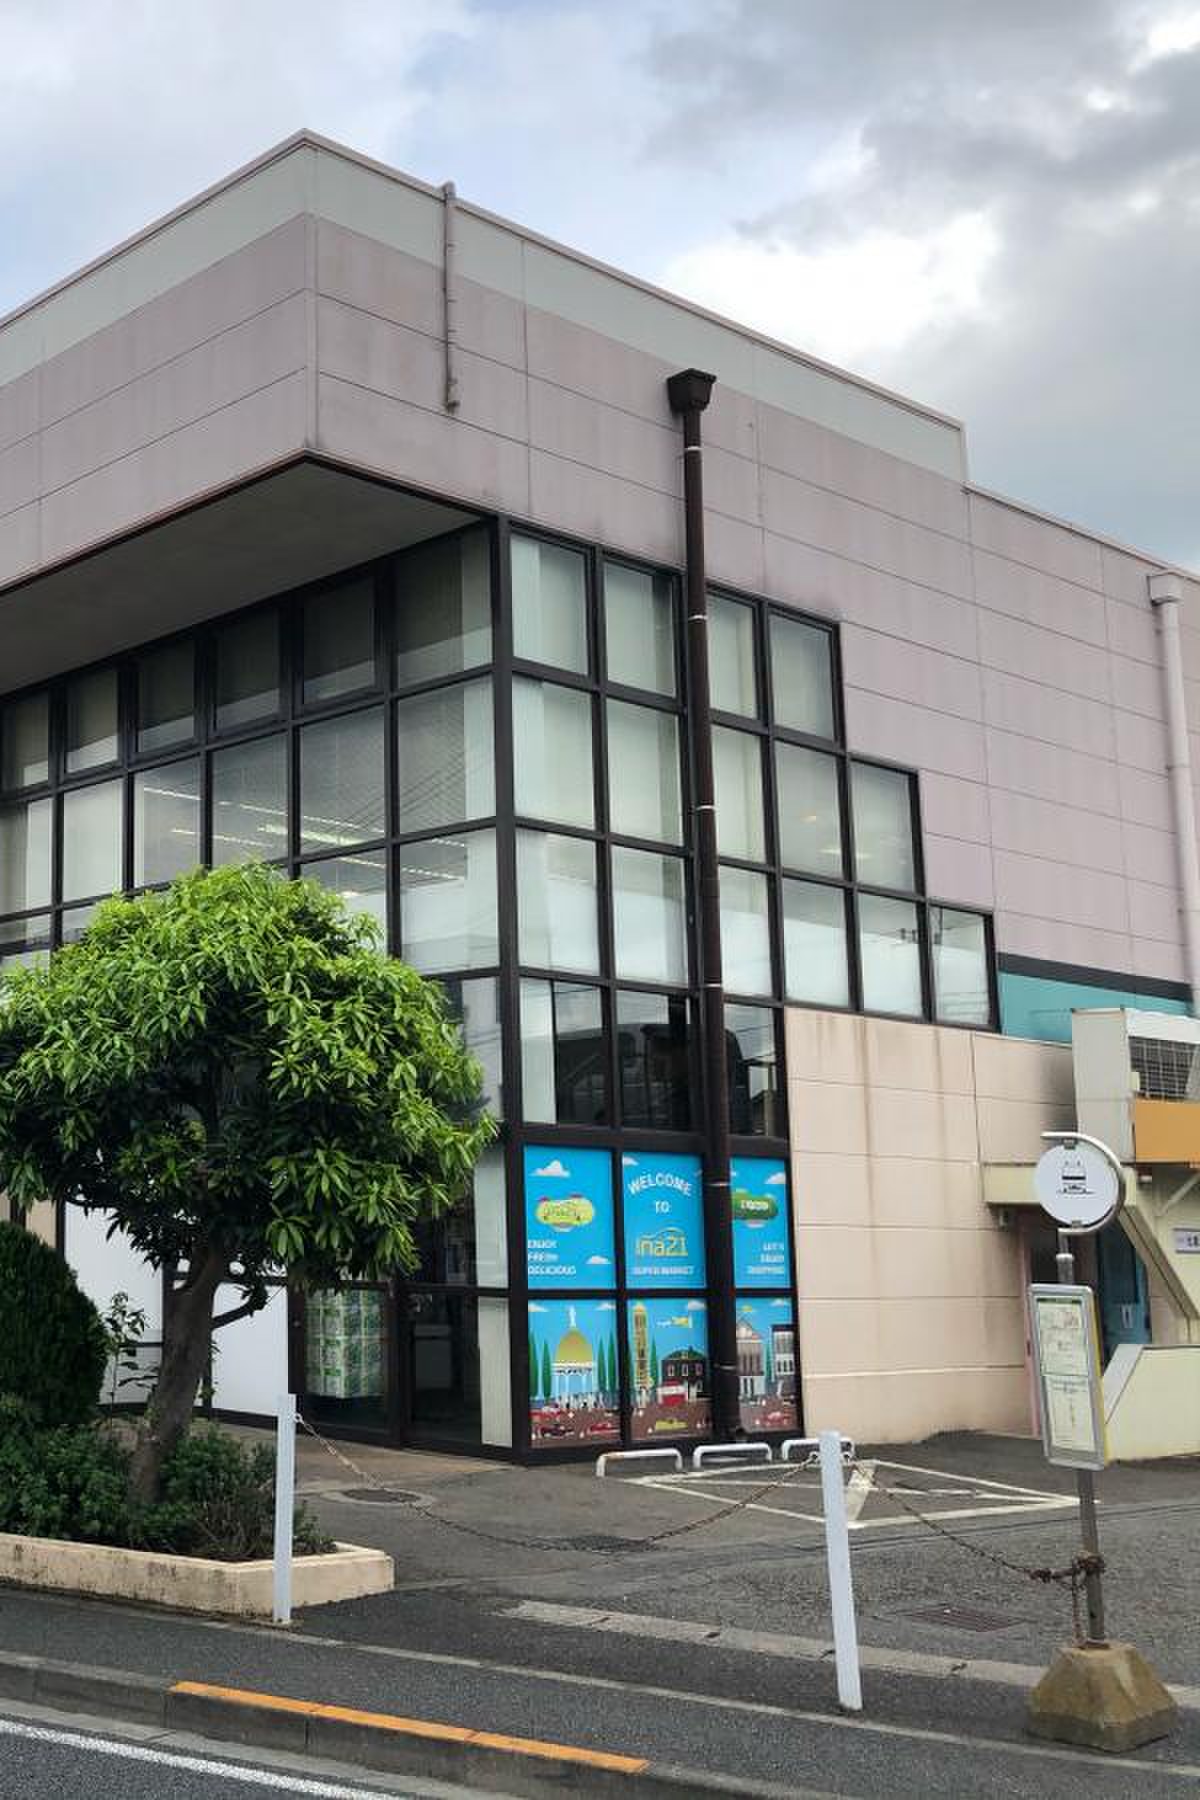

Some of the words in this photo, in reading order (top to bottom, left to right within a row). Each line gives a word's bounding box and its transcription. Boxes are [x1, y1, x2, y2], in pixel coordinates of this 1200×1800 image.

[627, 1172, 693, 1196] WELCOME
[654, 1200, 671, 1214] TO
[635, 1231, 689, 1257] ina21
